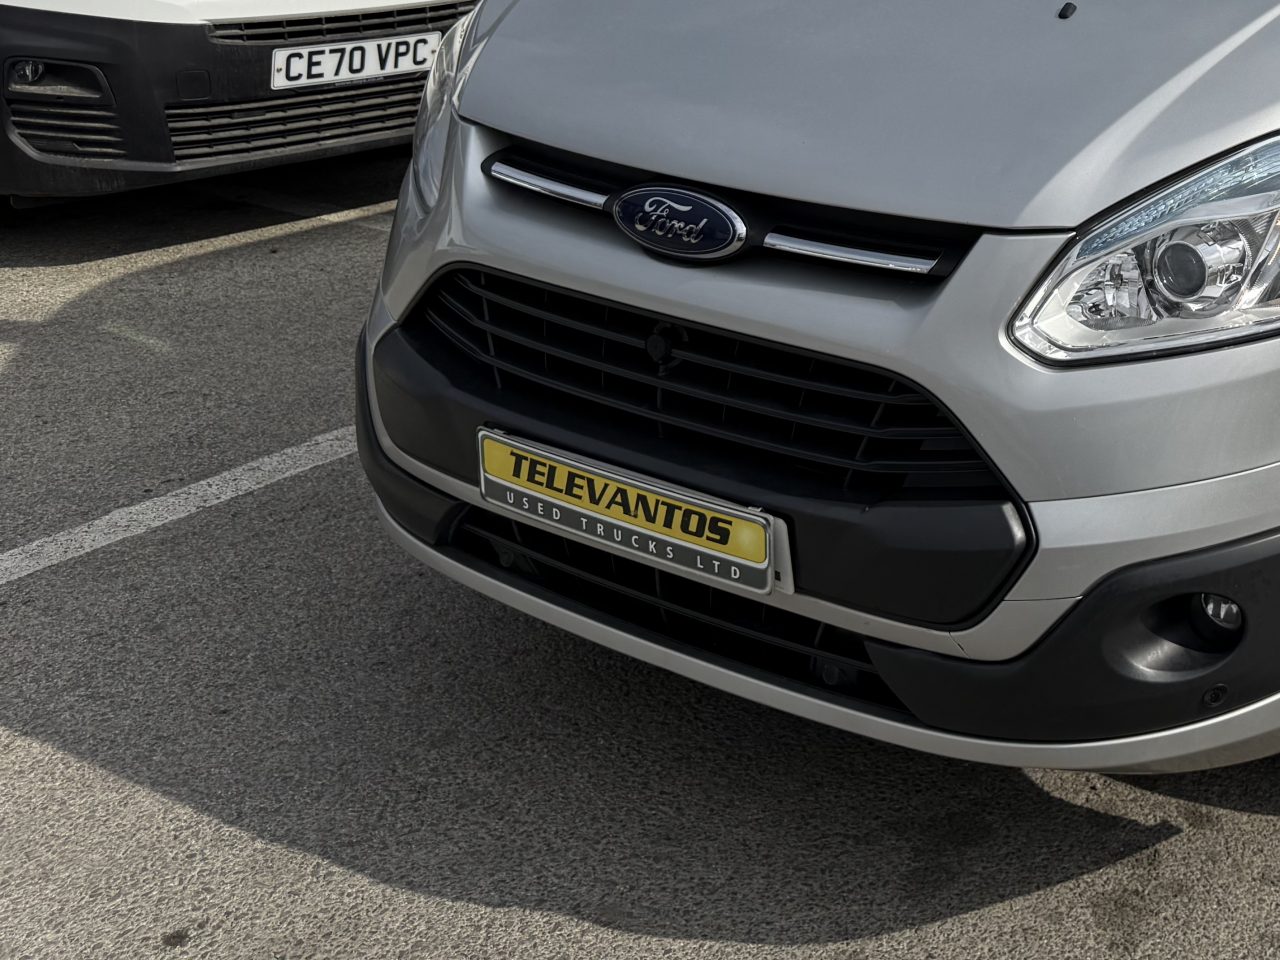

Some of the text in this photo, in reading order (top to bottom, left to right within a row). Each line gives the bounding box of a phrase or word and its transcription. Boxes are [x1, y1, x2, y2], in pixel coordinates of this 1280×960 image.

[285, 38, 428, 82] CE70 VPC
[635, 197, 708, 244] Ford
[510, 450, 733, 546] TELEVANTOS
[506, 490, 740, 579] USED TRUCKS LTD
